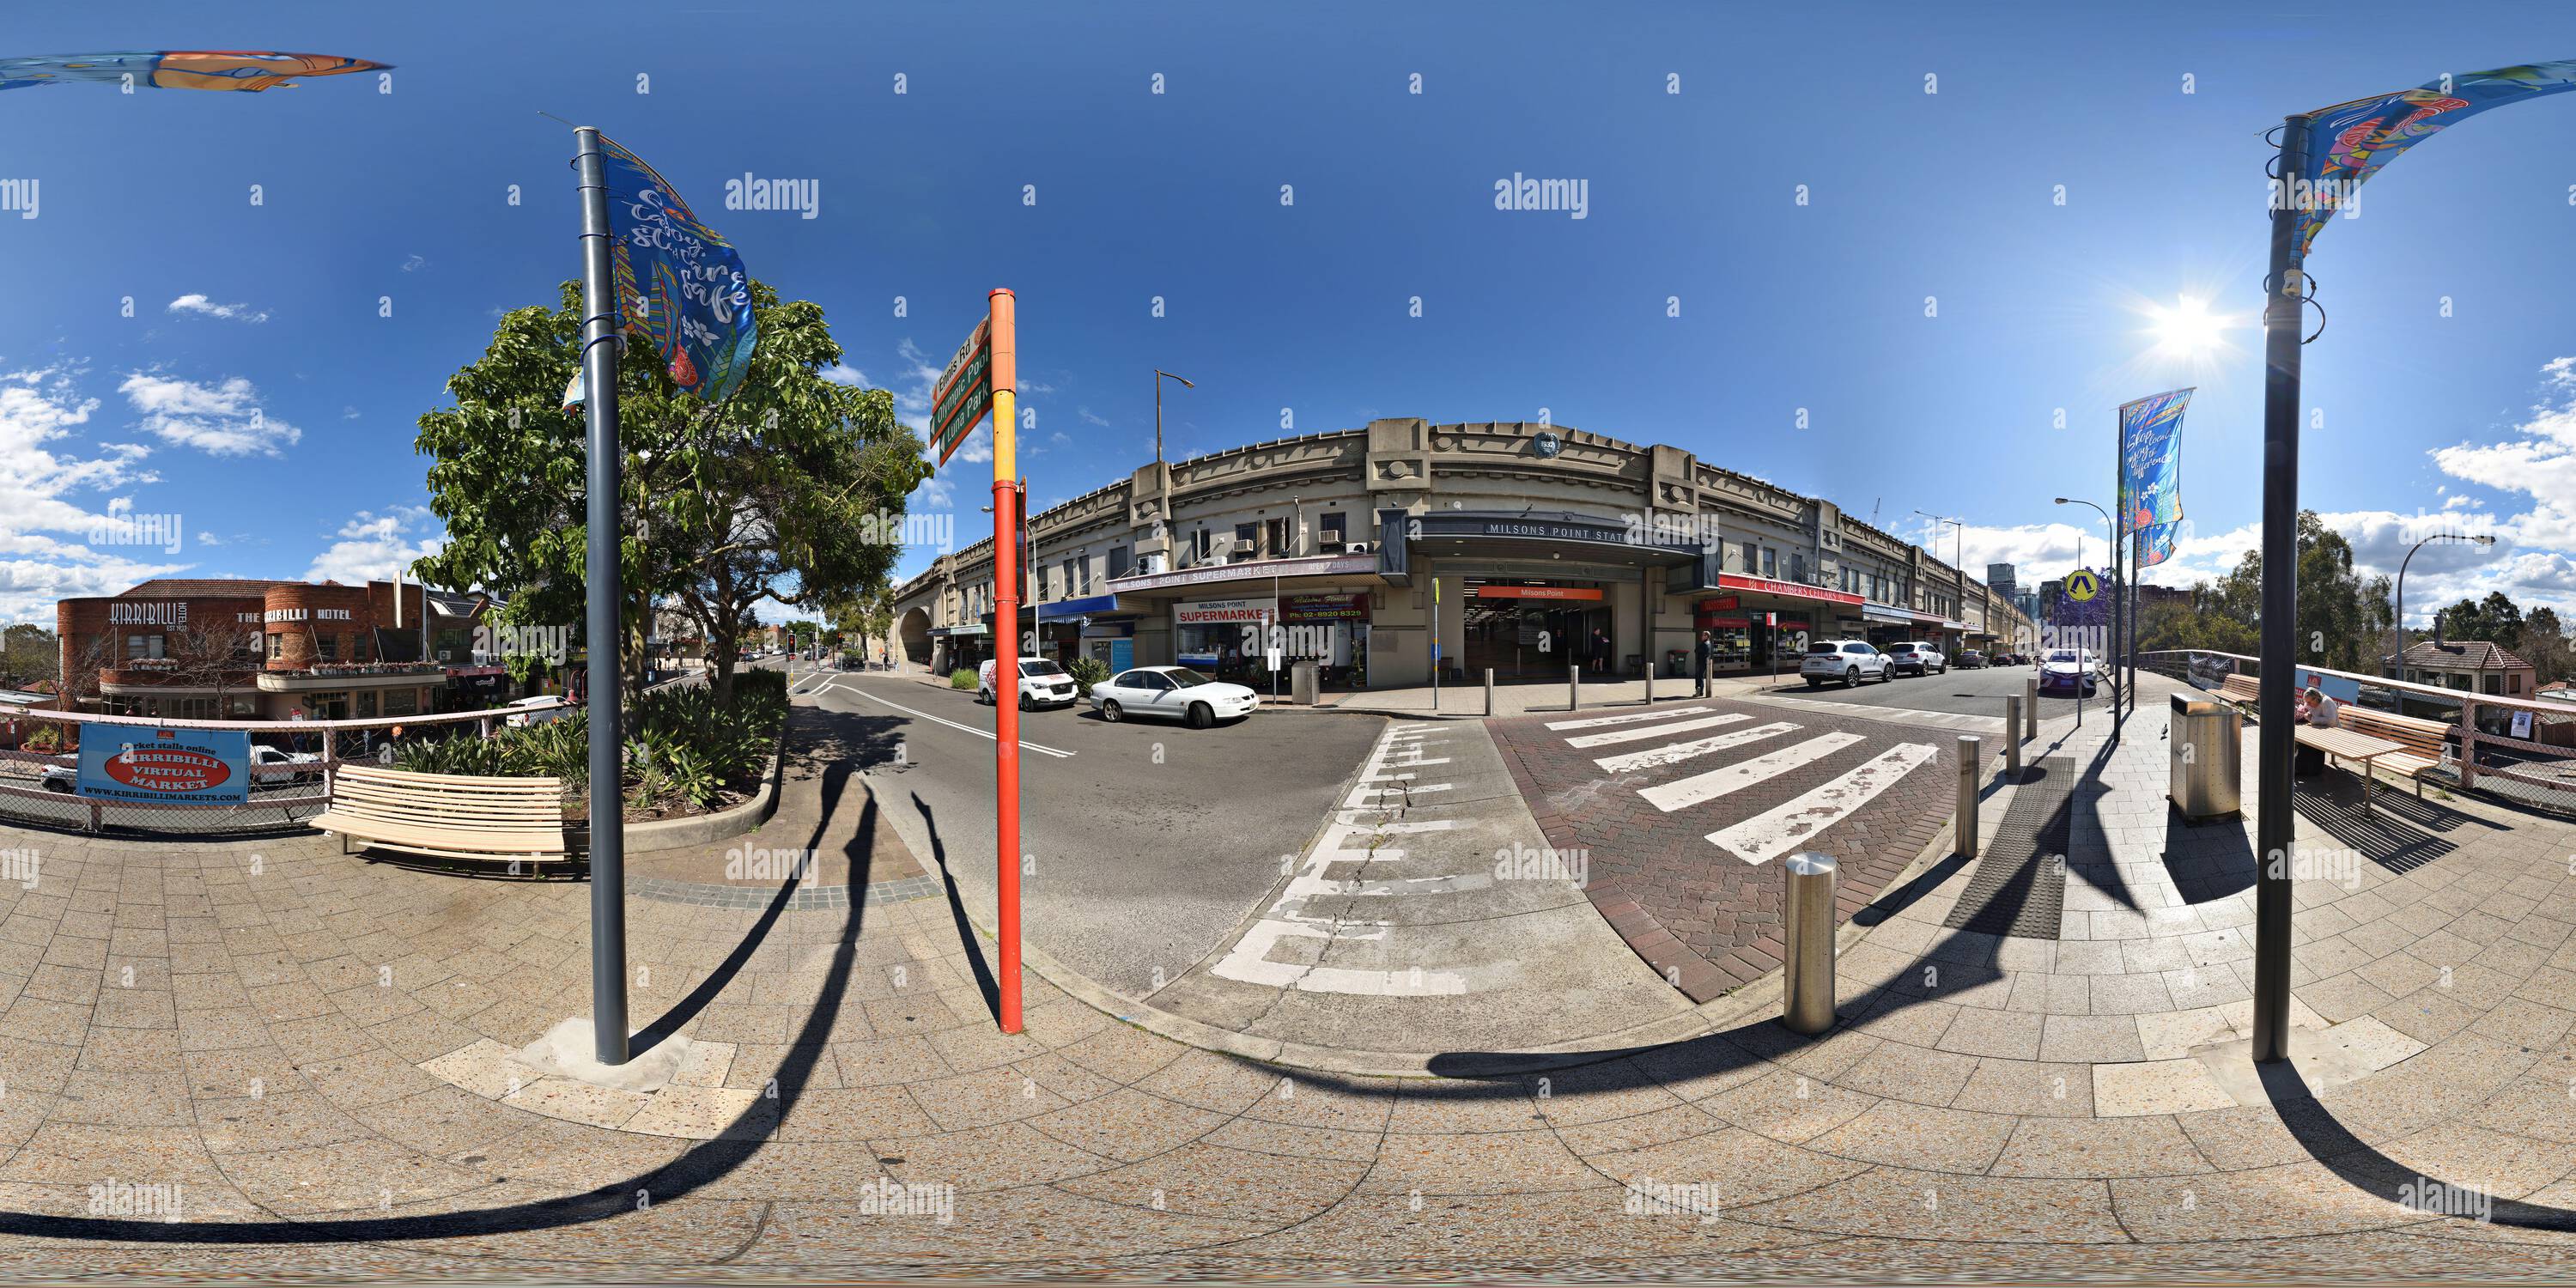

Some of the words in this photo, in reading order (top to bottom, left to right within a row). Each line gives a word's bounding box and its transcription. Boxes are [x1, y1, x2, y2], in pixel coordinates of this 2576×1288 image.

[939, 361, 957, 392] Ennis
[959, 338, 970, 363] Rd
[938, 378, 965, 423] Olympic
[968, 345, 988, 384] Pool
[947, 410, 965, 442] Luna
[967, 381, 988, 417] Park
[2127, 429, 2154, 453] Shop
[1490, 524, 1545, 535] MILSONS
[1552, 527, 1589, 539] POINT
[1595, 531, 1642, 544] STATION
[1308, 562, 1325, 571] OPEN
[1332, 561, 1350, 569] DAYS
[1117, 578, 1151, 590] MILSONS
[1159, 574, 1187, 585] POINT
[1192, 564, 1278, 581] SUPERMARKET
[1764, 581, 1807, 597] CHAMBERS
[1809, 588, 1836, 601] CELLARS
[109, 603, 176, 625] KIRRIBILLI
[178, 602, 187, 625] HOTEL
[236, 612, 260, 623] THE
[317, 609, 351, 620] HOTEL
[1180, 608, 1274, 622] SUPERMARKE
[185, 744, 216, 755] online
[132, 766, 206, 778] VIRTUAL
[129, 775, 208, 790] MARKET
[84, 786, 240, 802] WWW.KIRRIBILLIMARKETS.COM
